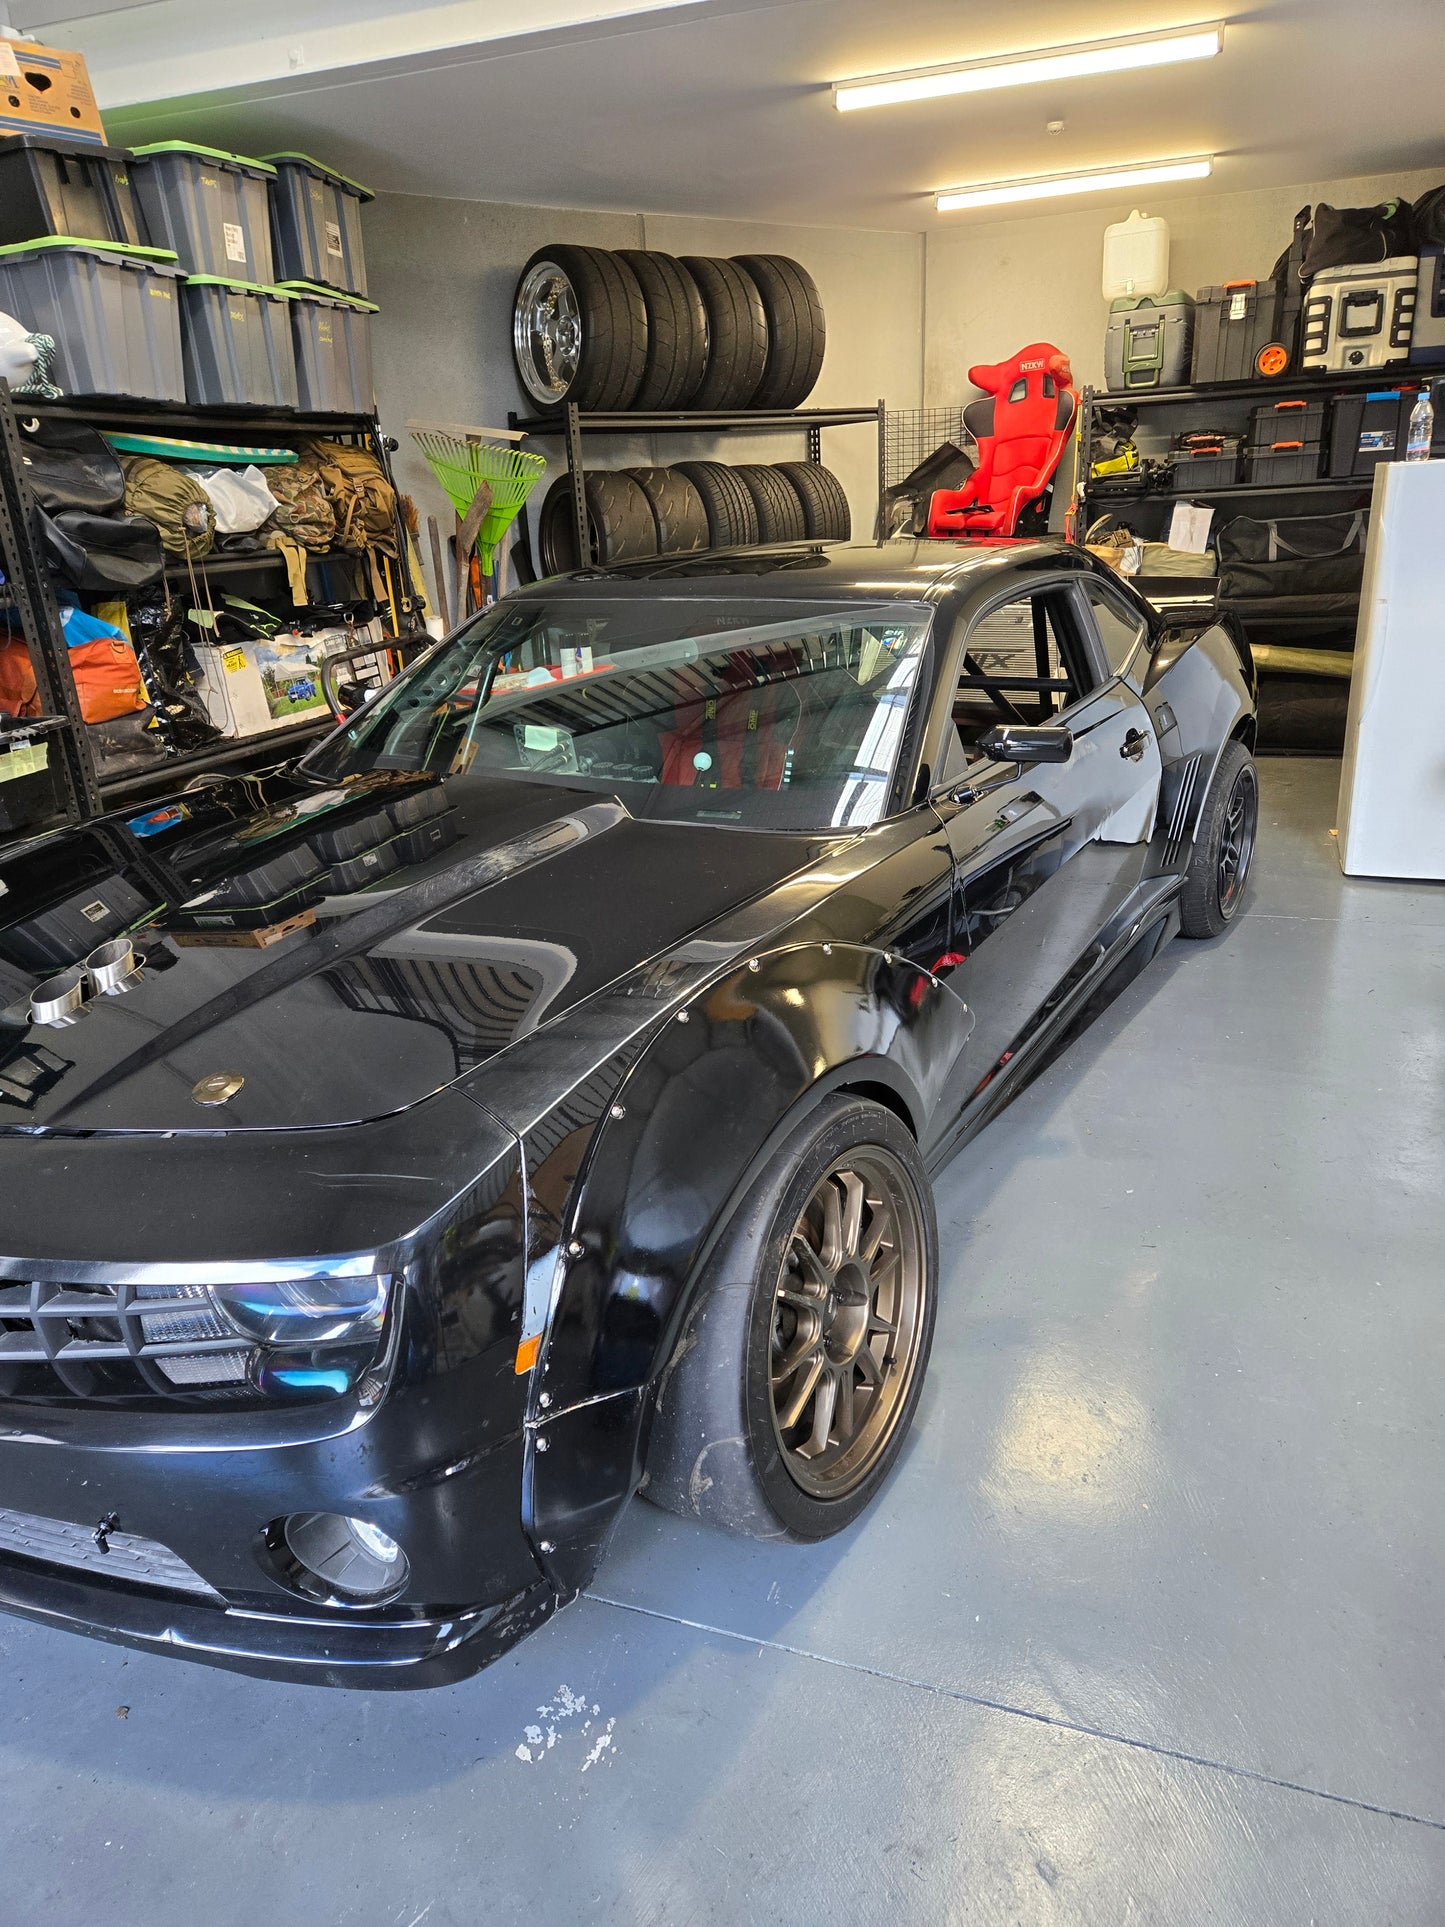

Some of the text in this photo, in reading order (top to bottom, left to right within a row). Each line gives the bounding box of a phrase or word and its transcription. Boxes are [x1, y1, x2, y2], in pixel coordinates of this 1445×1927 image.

[1021, 360, 1044, 371] NZKW
[707, 699, 715, 720] OMP
[749, 710, 758, 730] OMP
